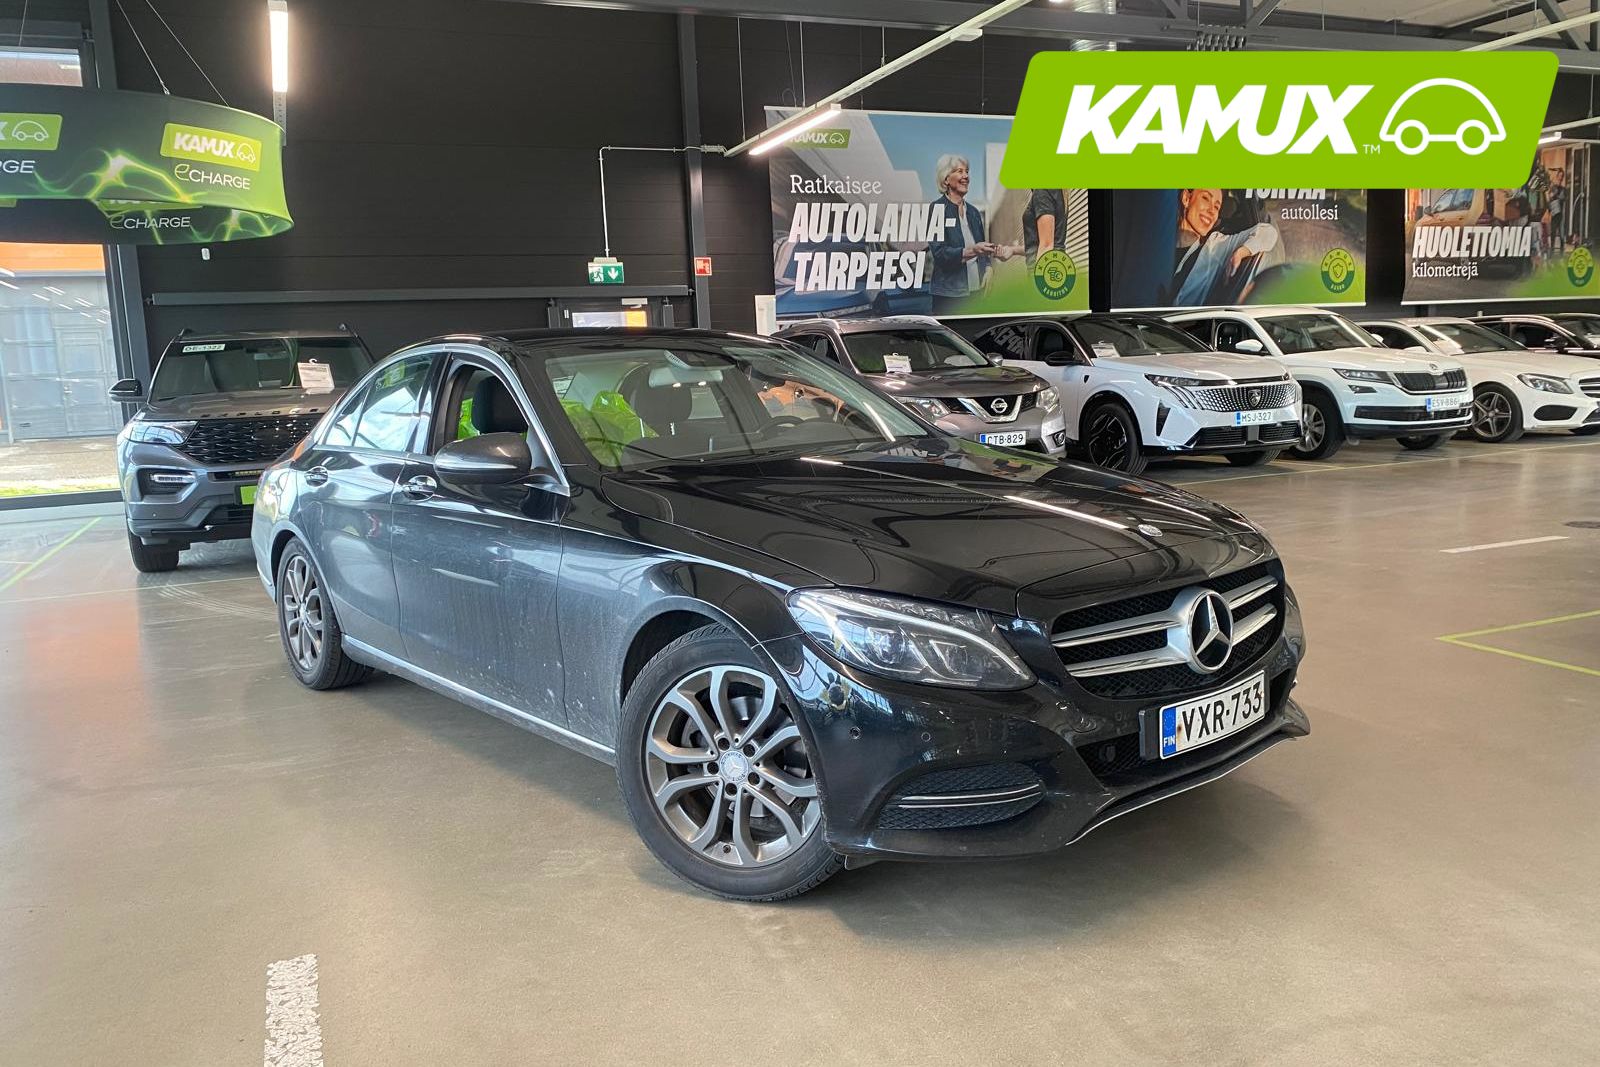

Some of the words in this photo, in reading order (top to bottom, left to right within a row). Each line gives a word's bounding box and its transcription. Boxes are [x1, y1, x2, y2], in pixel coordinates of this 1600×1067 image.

[174, 132, 235, 158] KAMUX
[790, 174, 882, 195] Ratkaisee
[788, 202, 957, 243] AUTOLAINA-
[1281, 204, 1339, 220] autollesi
[1412, 226, 1532, 258] HUOLETTOMIA
[794, 250, 926, 292] TARPEESI
[1412, 262, 1479, 280] kilometrejä
[1182, 681, 1263, 742] VXR-733
[1163, 735, 1176, 748] FIN
